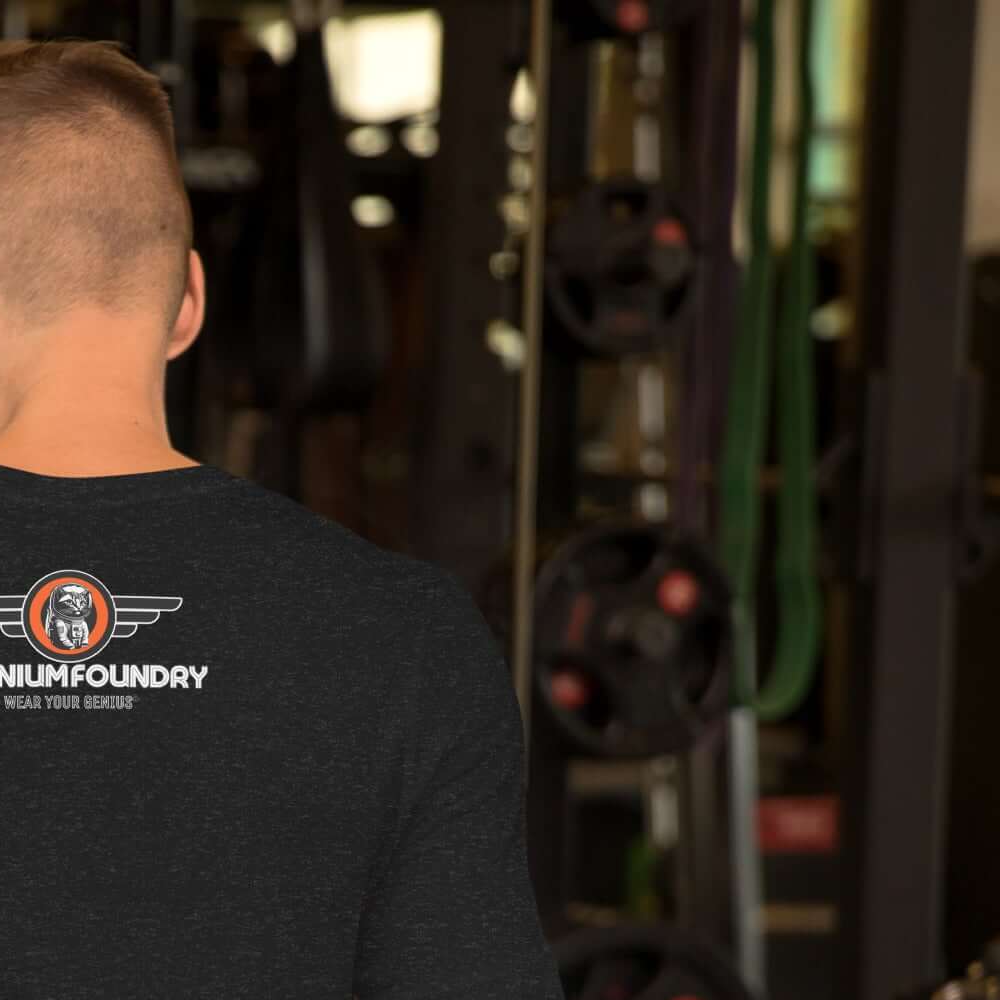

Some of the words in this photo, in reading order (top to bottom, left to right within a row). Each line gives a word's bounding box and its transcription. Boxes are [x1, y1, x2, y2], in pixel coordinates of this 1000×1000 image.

[3, 695, 41, 710] WEAR
[44, 695, 80, 710] YOUR
[83, 695, 133, 710] GENIUS
